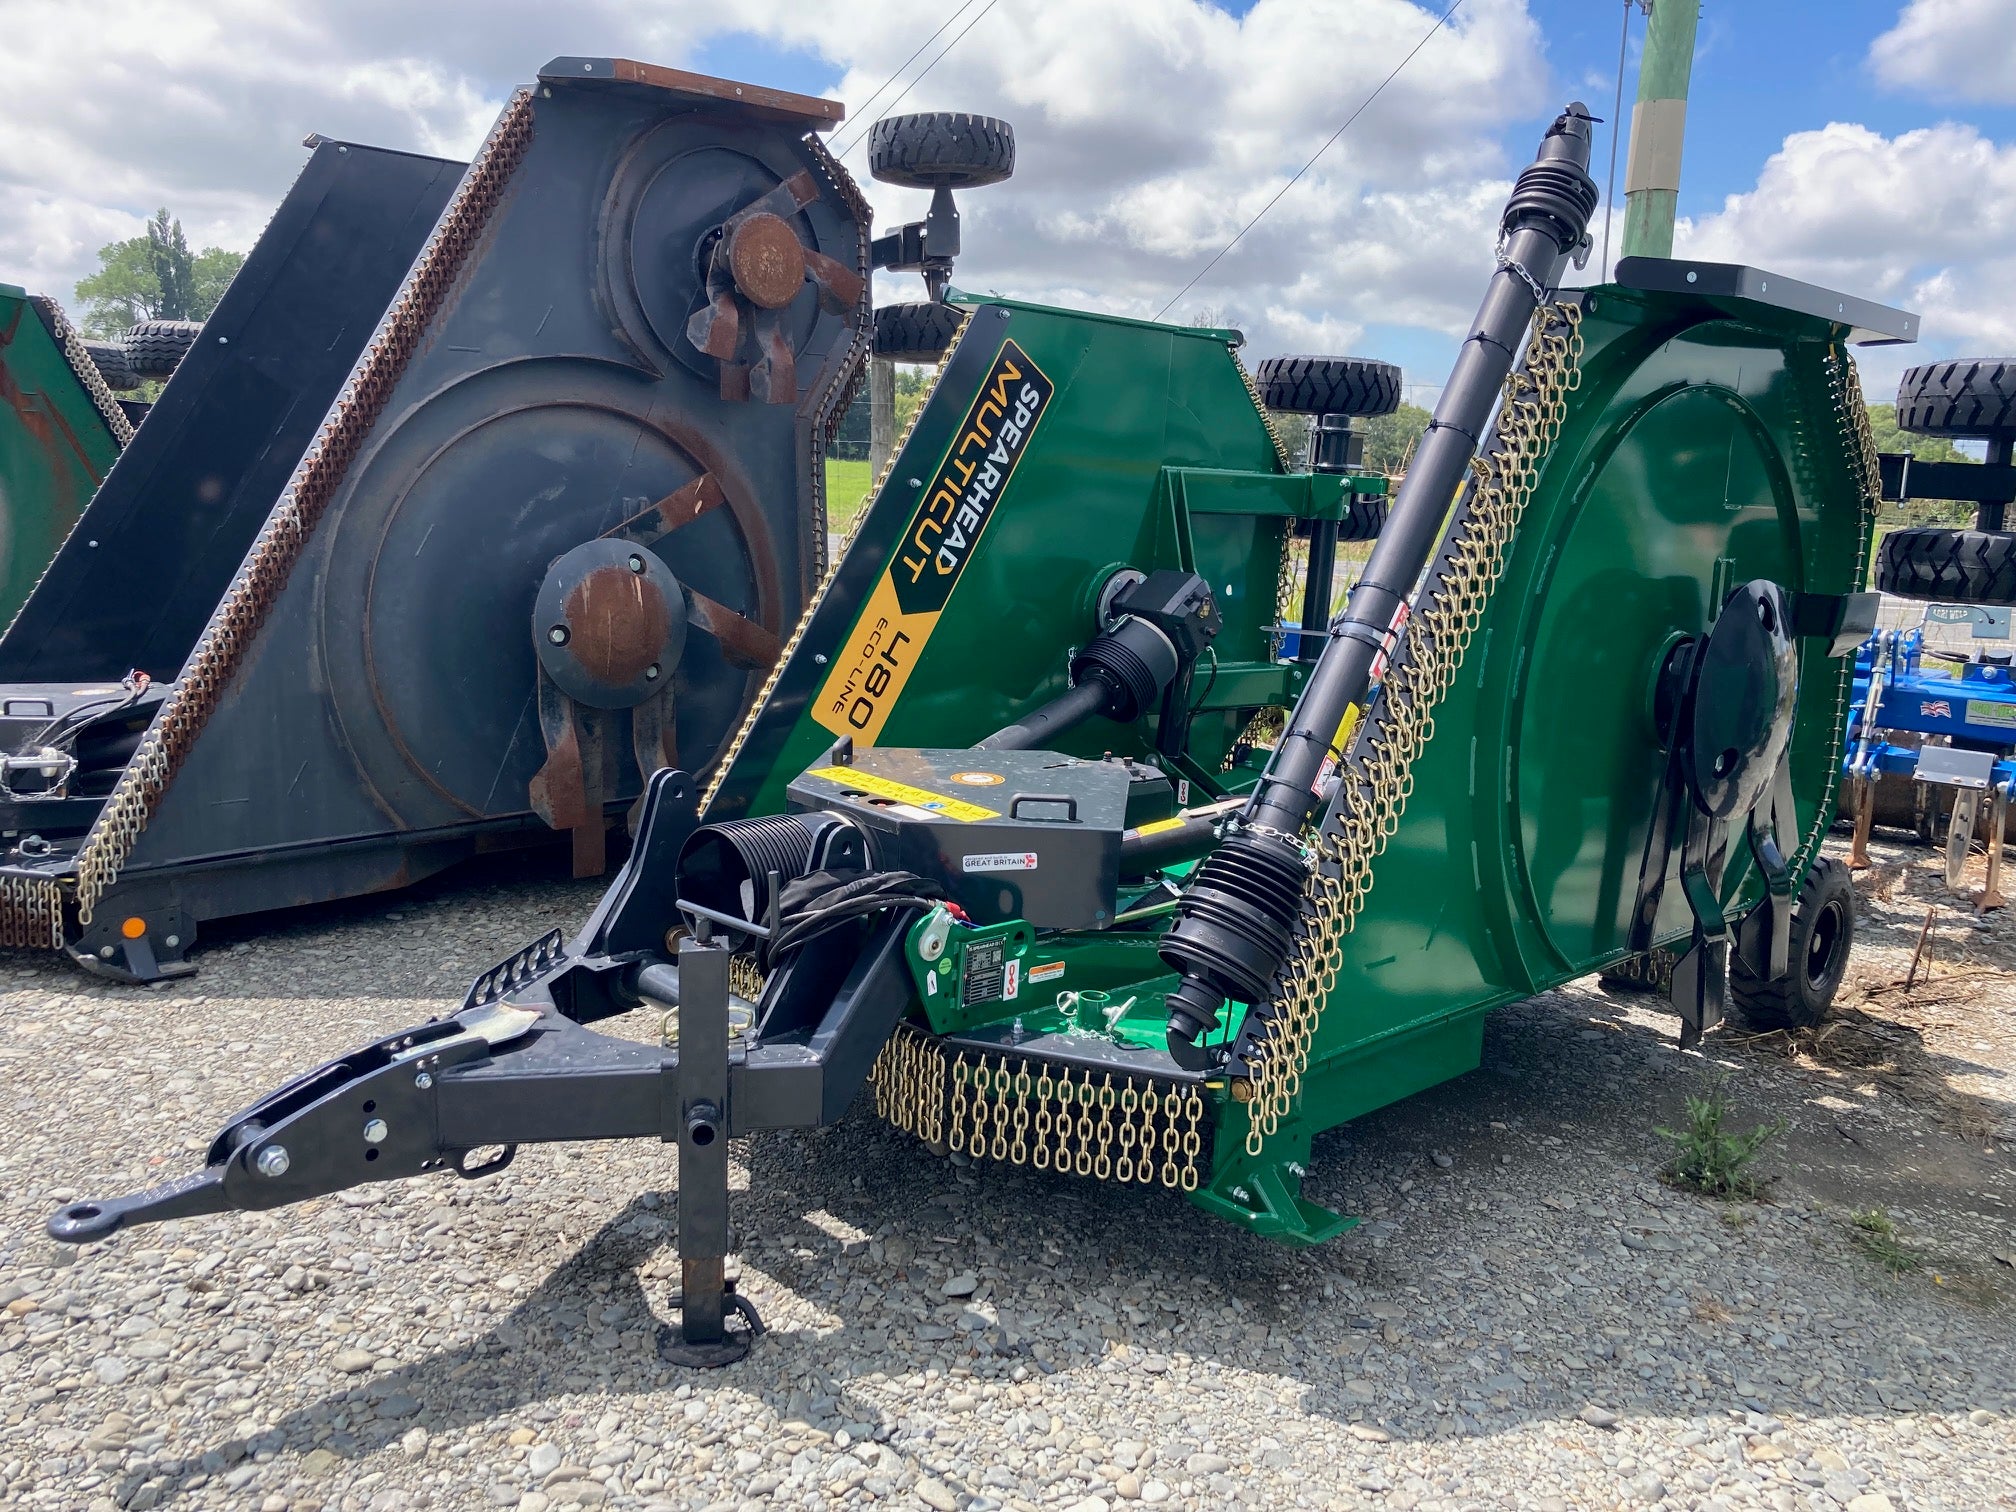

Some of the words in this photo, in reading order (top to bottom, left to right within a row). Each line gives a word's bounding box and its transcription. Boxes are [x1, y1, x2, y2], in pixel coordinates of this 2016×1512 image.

[902, 360, 1022, 584] MULTICUT
[935, 382, 1040, 576] SPEARHEAD
[832, 617, 888, 714] ECO-LINE
[848, 630, 910, 729] 480
[964, 860, 991, 868] GREAT
[993, 858, 1025, 866] BRITAIN
